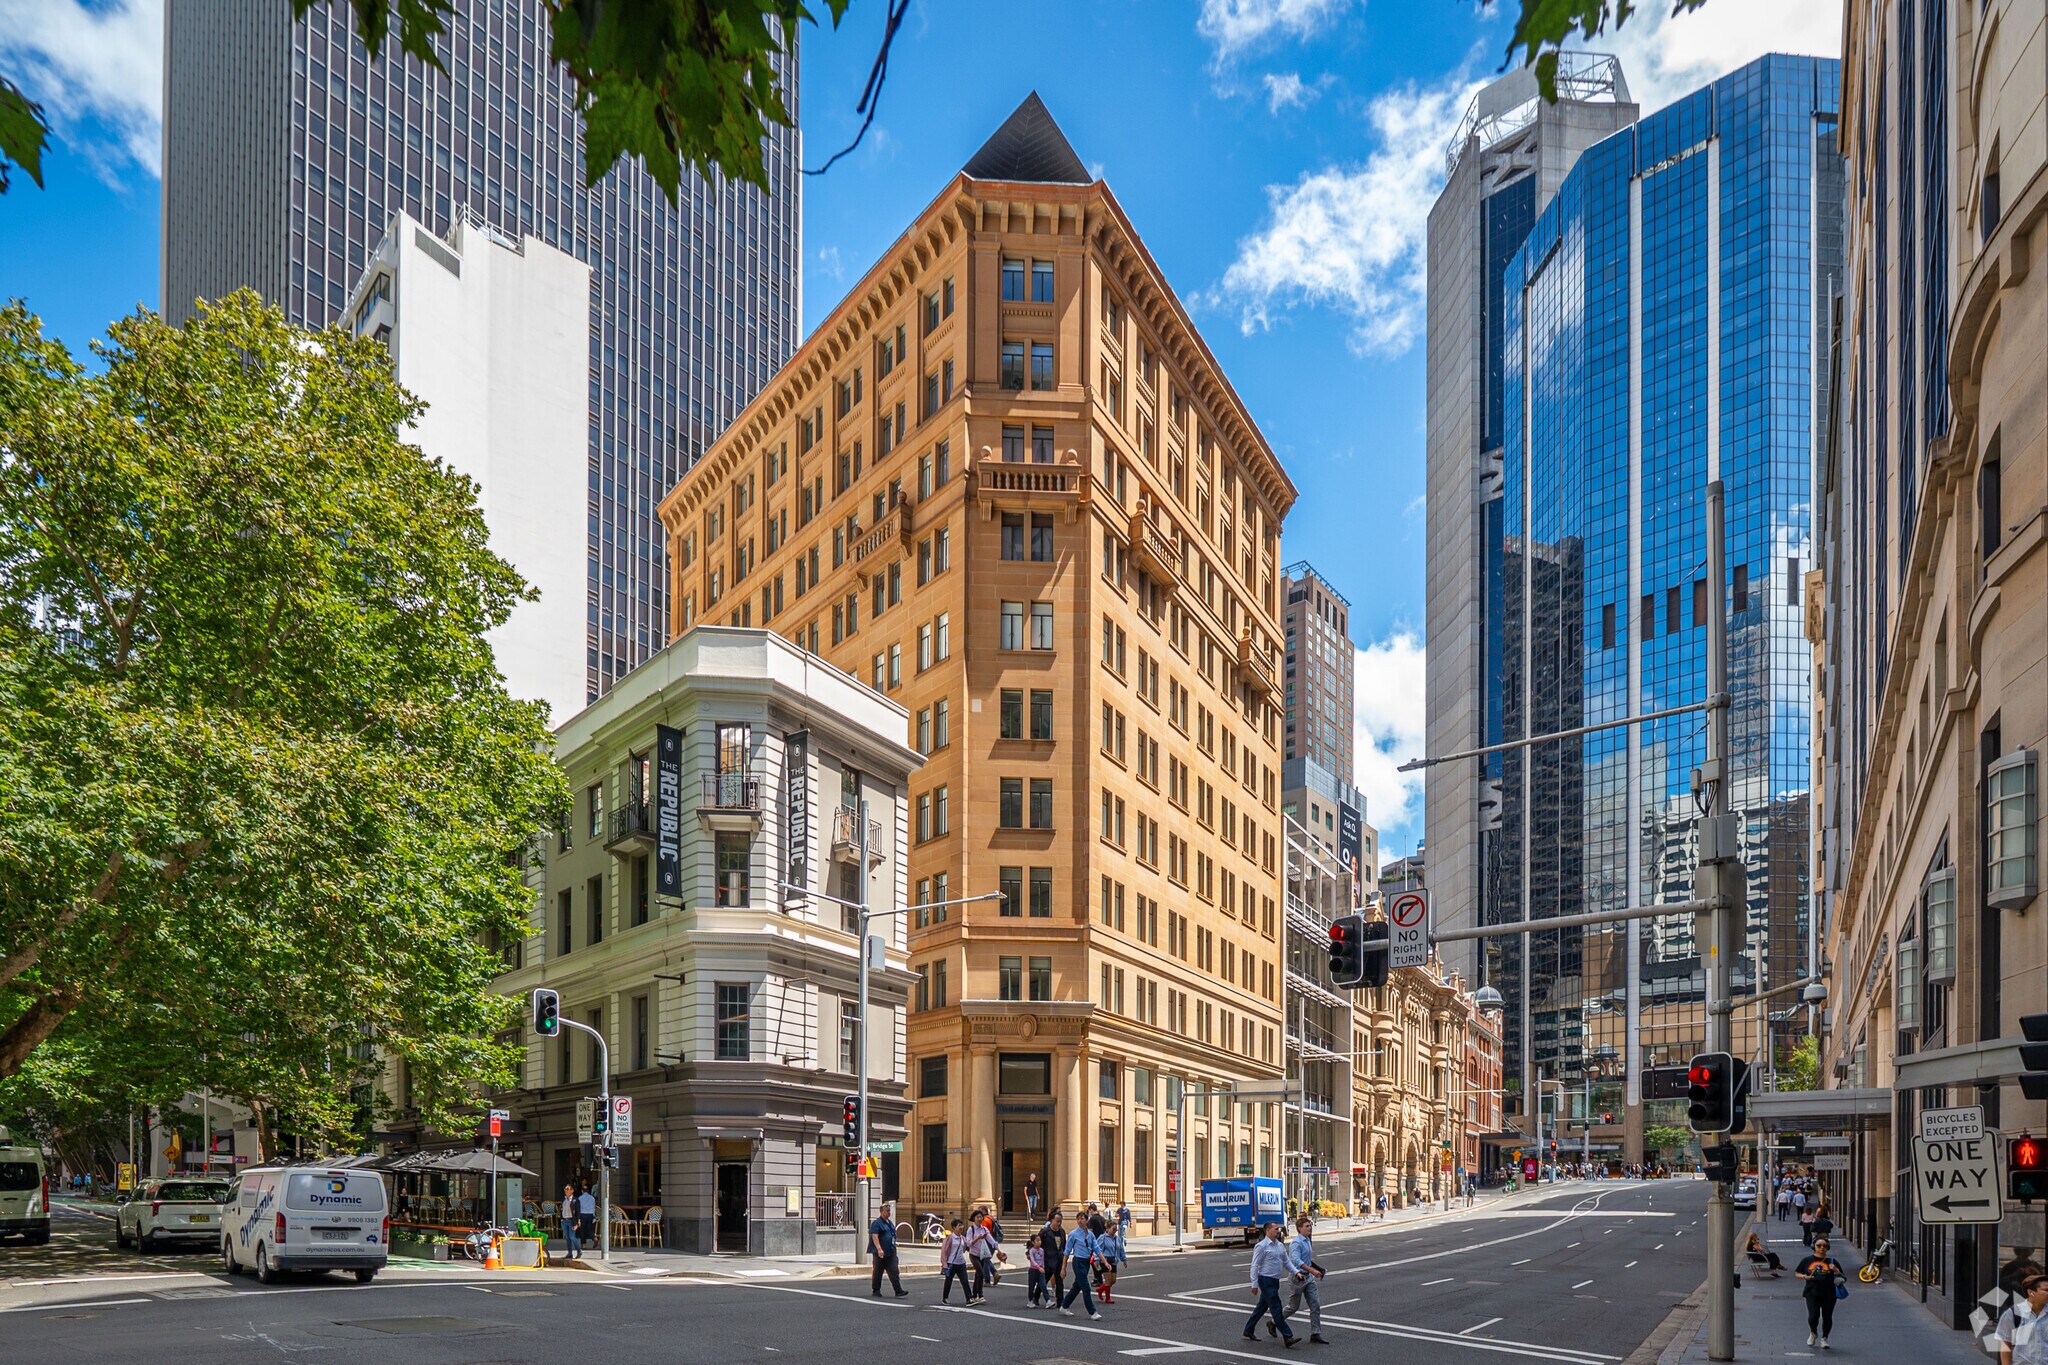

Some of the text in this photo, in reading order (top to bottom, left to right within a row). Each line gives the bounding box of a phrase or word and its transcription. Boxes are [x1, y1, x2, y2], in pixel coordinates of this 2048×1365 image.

[660, 760, 678, 771] THE
[790, 766, 804, 776] THE
[659, 770, 678, 863] REPUBLIC
[790, 776, 805, 867] REPUBLIC
[1342, 848, 1350, 865] Q
[1398, 930, 1419, 943] NO
[1393, 943, 1424, 954] RIGHT
[1394, 954, 1423, 965] TURN
[578, 1103, 591, 1112] ONE
[1926, 1113, 1977, 1125] BICYCLES
[1926, 1125, 1979, 1136] EXCEPTED
[1926, 1140, 1983, 1162] ONE
[1924, 1168, 1988, 1190] WAY
[310, 1194, 362, 1206] Dynamic
[1209, 1194, 1246, 1203] MILKRUN
[1259, 1191, 1280, 1205] MILKRUN
[240, 1184, 275, 1248] Dynamic
[305, 1246, 365, 1254] dynamicos.com.au
